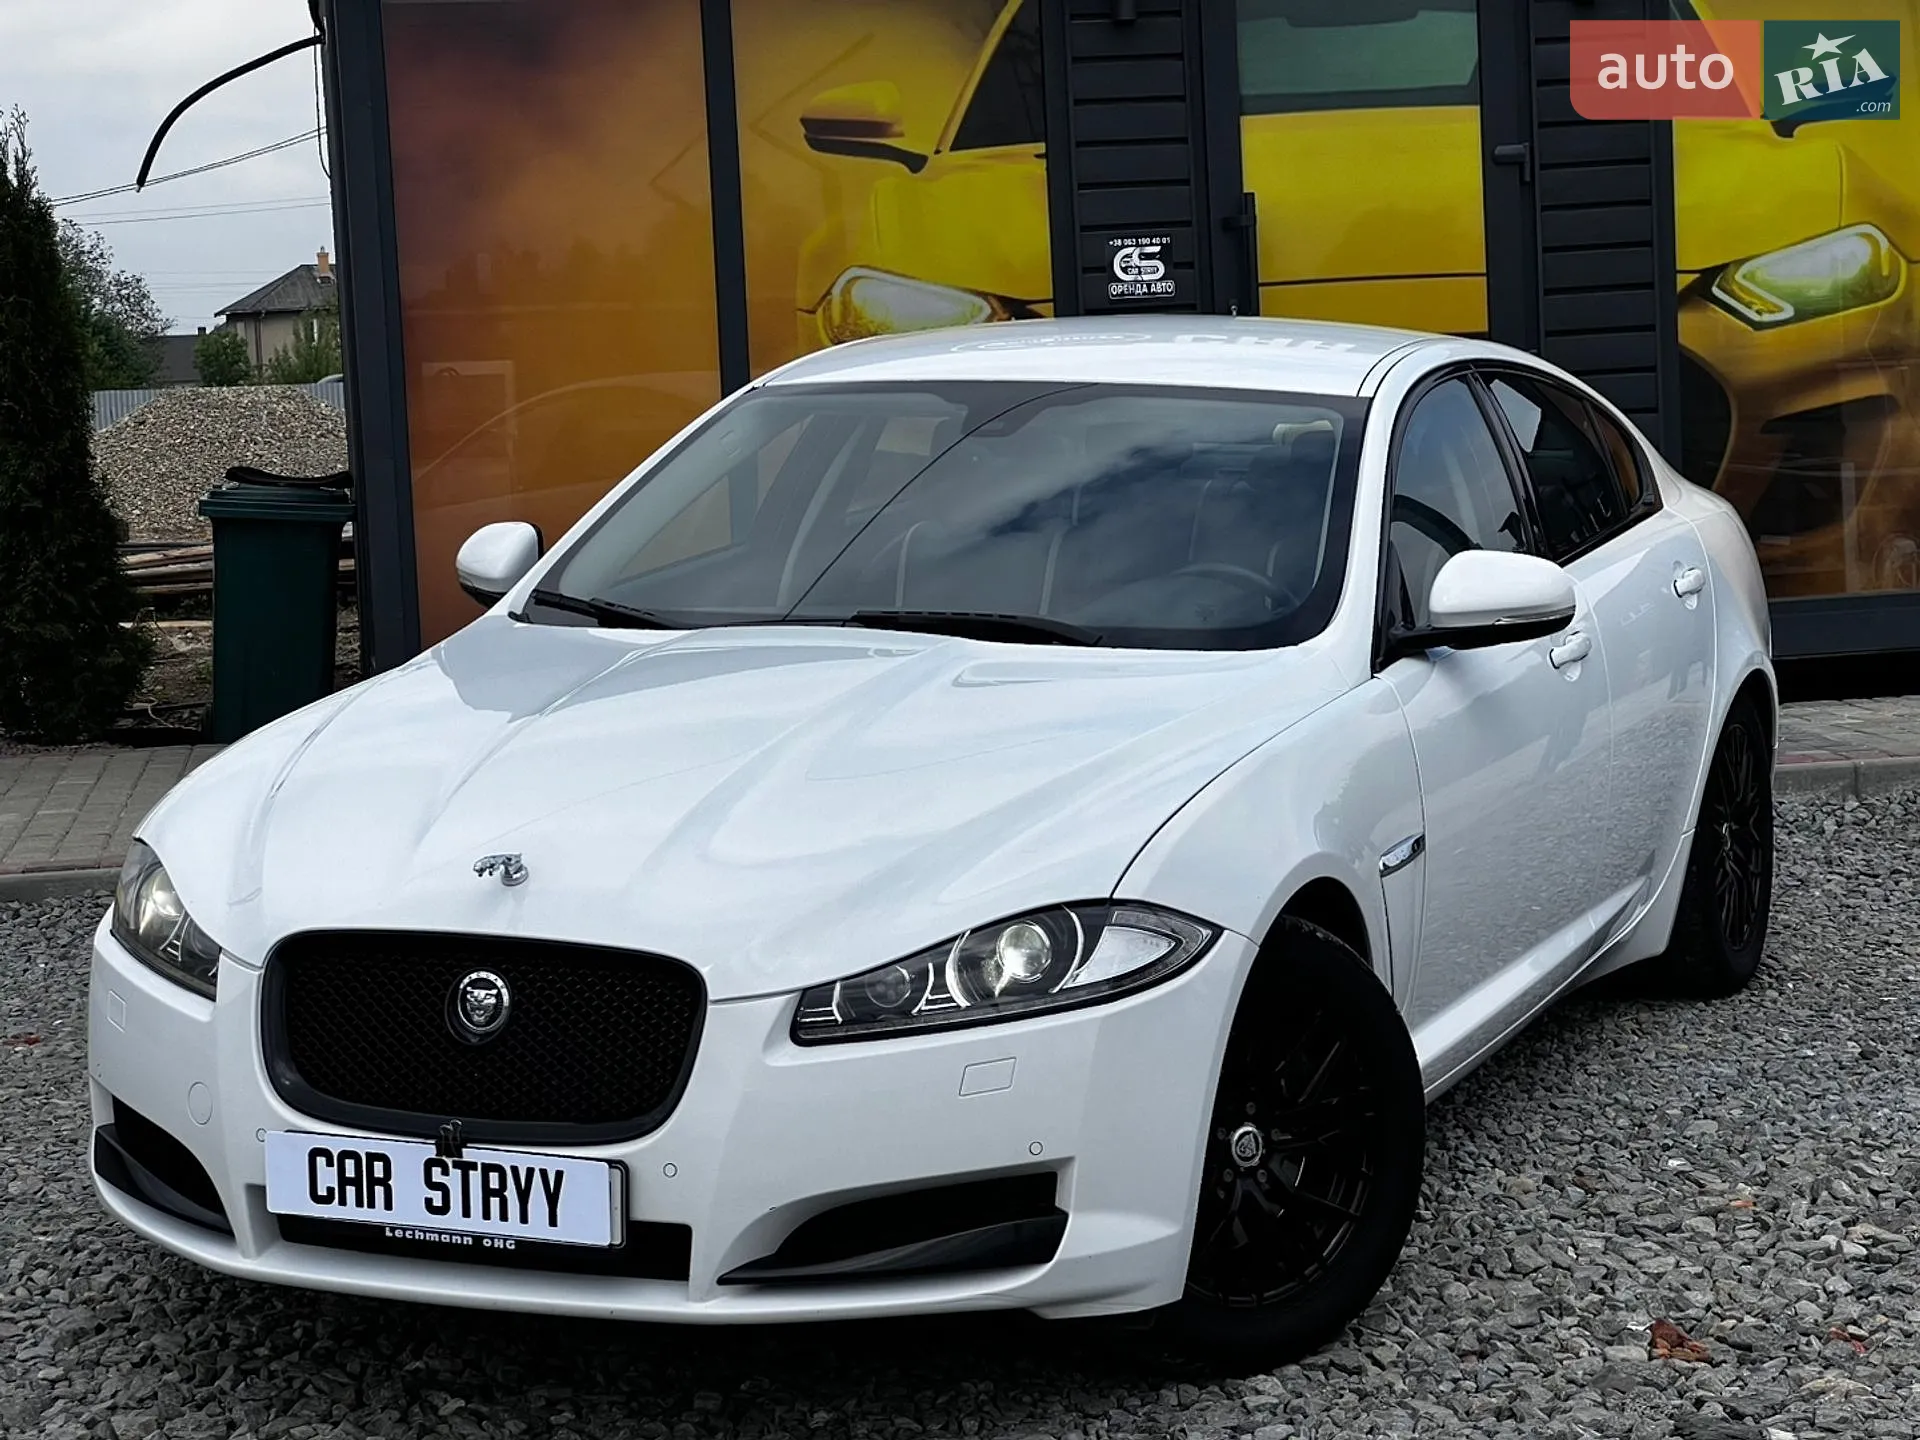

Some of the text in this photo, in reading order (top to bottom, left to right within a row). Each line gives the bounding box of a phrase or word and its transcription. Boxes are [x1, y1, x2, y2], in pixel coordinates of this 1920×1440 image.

[1110, 282, 1173, 295] ОРЕНДА АВТО
[308, 1147, 564, 1228] CAR STRYY
[385, 1227, 473, 1246] Lechmann
